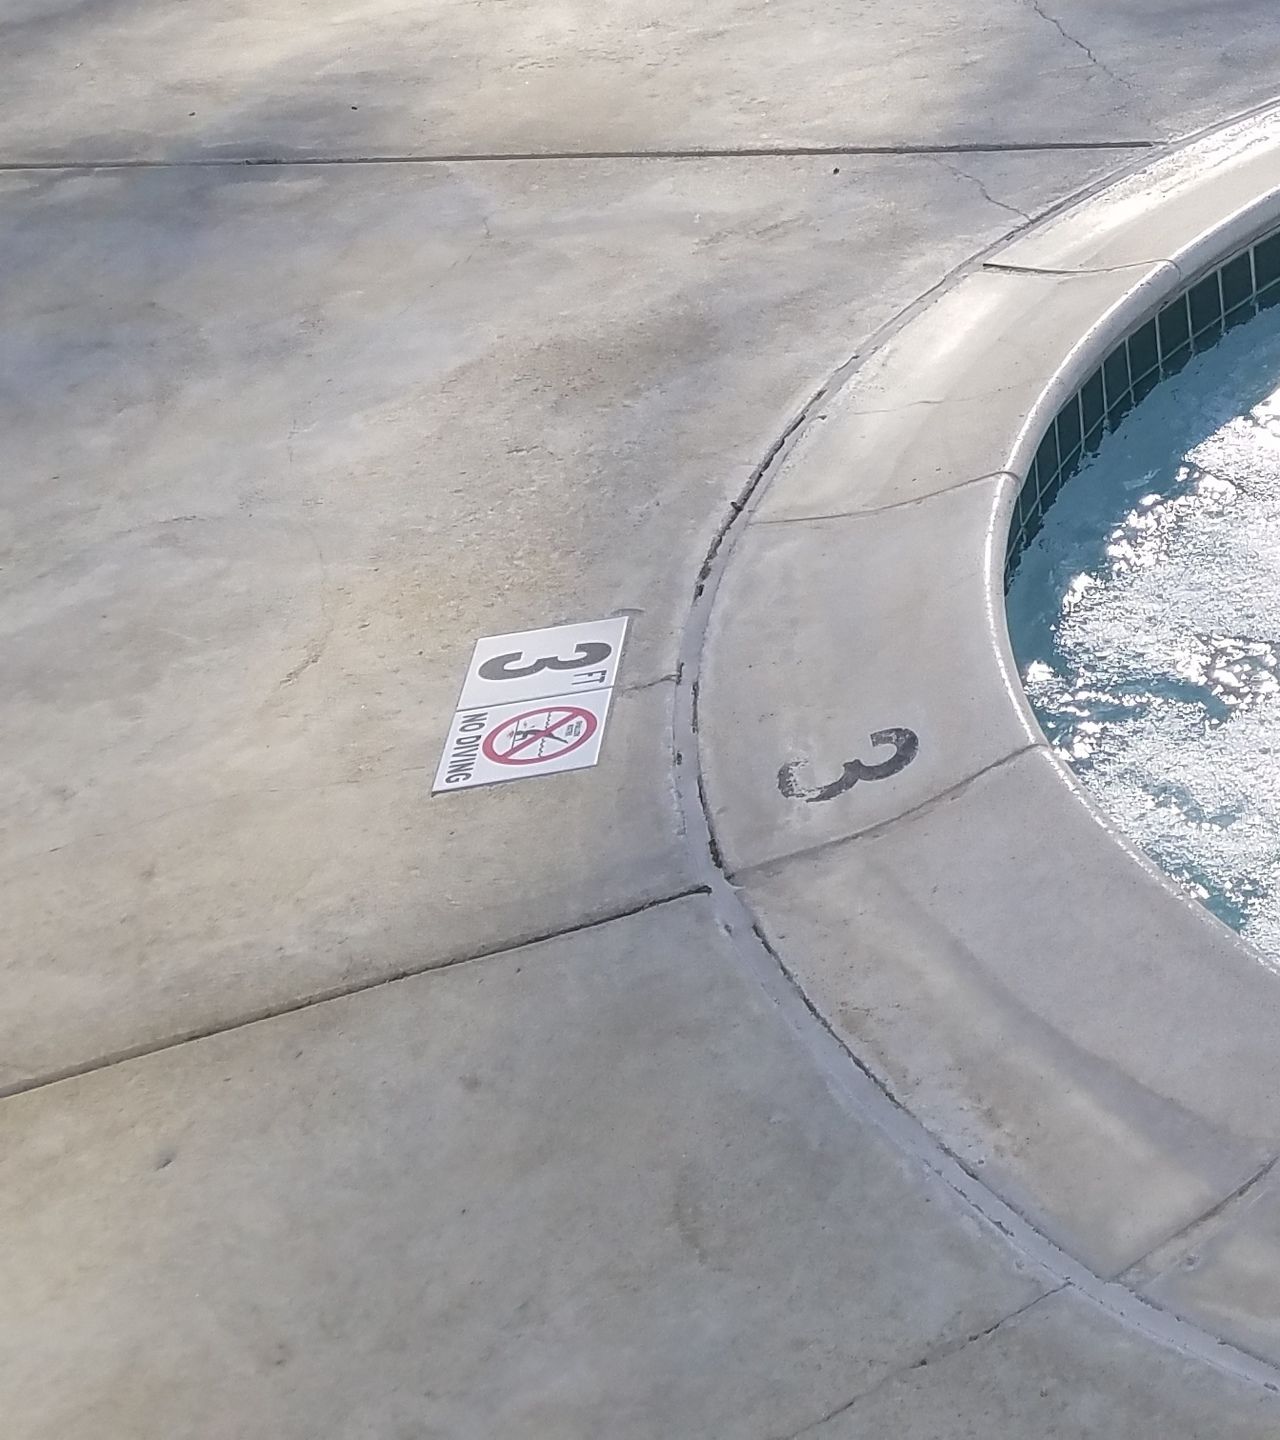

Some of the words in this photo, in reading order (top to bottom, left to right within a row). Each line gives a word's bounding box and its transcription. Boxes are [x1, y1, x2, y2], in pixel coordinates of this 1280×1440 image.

[478, 642, 613, 681] 3
[571, 669, 608, 686] FT
[458, 711, 489, 733] NO
[444, 734, 483, 785] DIVING
[777, 727, 920, 804] 3
